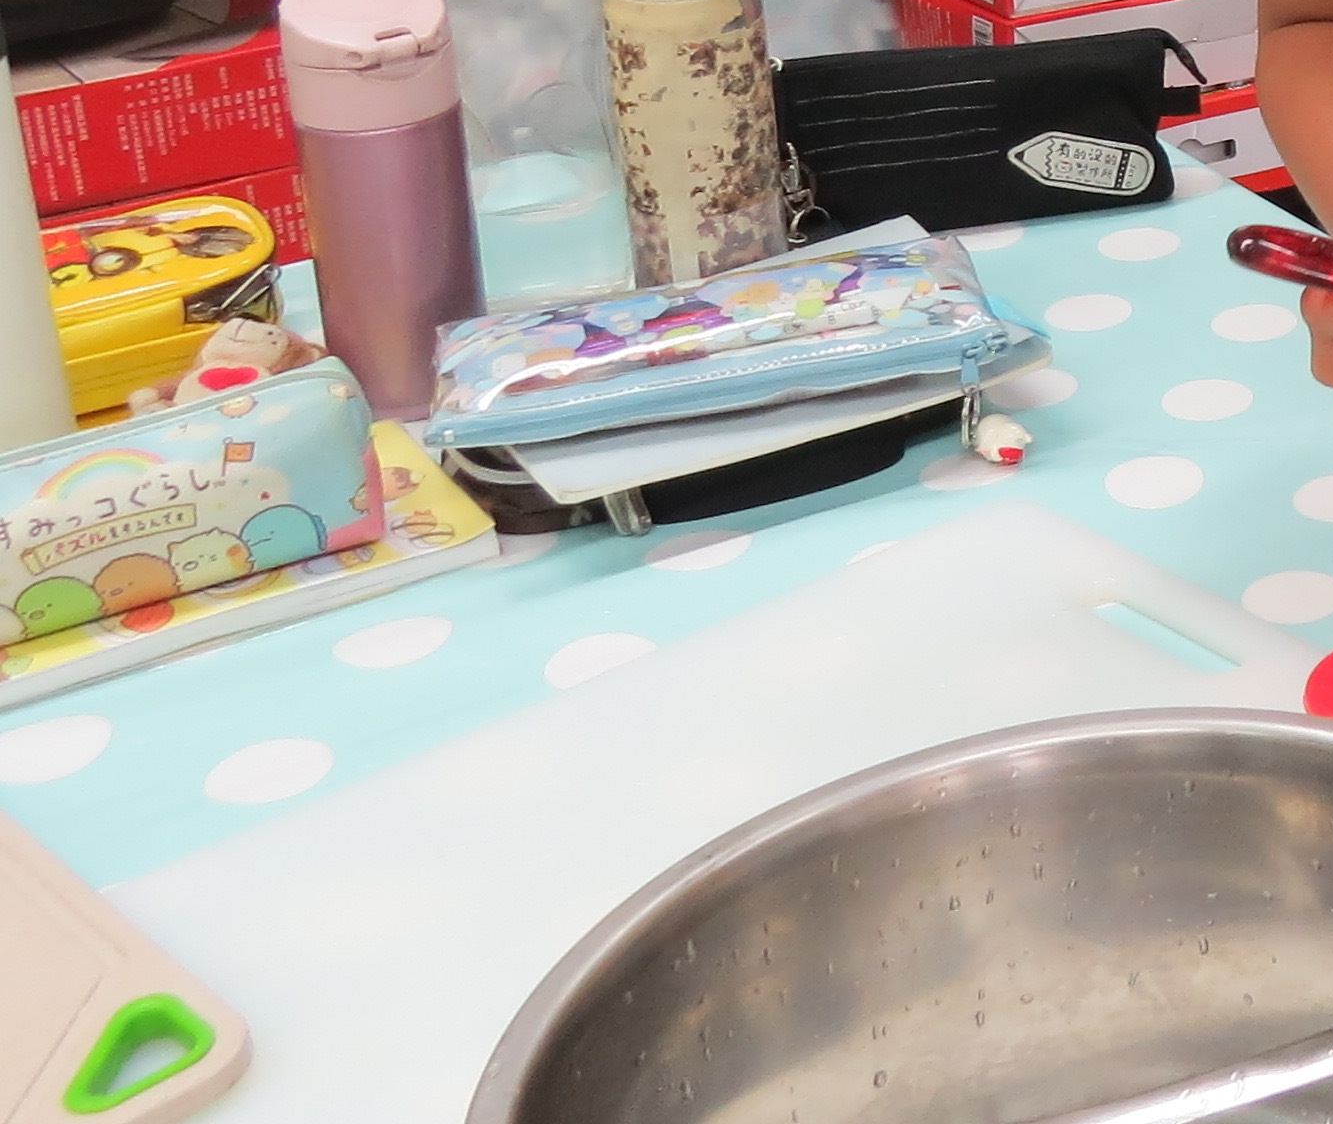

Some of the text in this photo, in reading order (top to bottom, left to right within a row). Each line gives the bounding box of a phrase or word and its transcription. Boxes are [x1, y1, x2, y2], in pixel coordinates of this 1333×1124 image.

[1055, 142, 1118, 166] 有的沒的
[0, 468, 210, 550] すみっコぐらし
